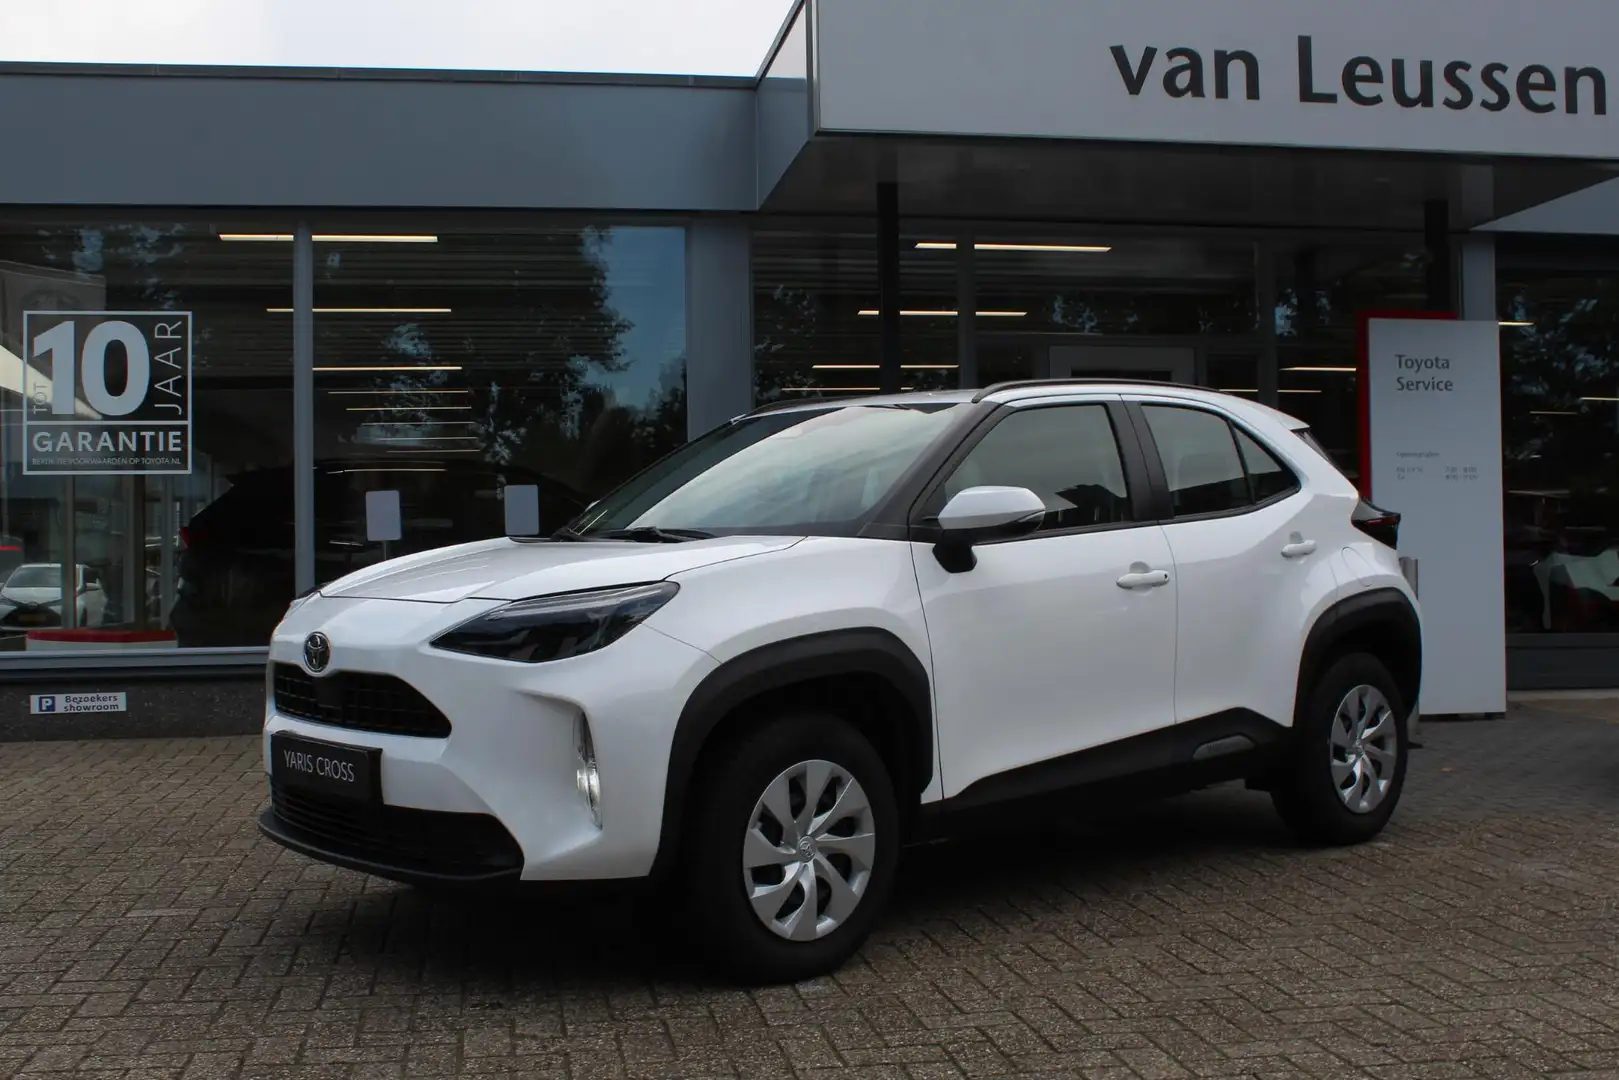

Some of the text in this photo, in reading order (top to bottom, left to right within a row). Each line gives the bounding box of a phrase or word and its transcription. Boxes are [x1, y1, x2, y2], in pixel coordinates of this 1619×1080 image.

[1109, 35, 1607, 115] van Leussen
[32, 320, 150, 416] 10
[154, 321, 182, 415] JAAR
[1394, 354, 1450, 373] Toyota
[1396, 376, 1453, 391] Service
[32, 382, 48, 415] TOT
[33, 431, 182, 452] GARANTIE
[128, 457, 141, 465] OP
[63, 703, 119, 712] showroom
[65, 695, 118, 704] Bezoekers
[283, 749, 355, 782] YARIS CROSS
